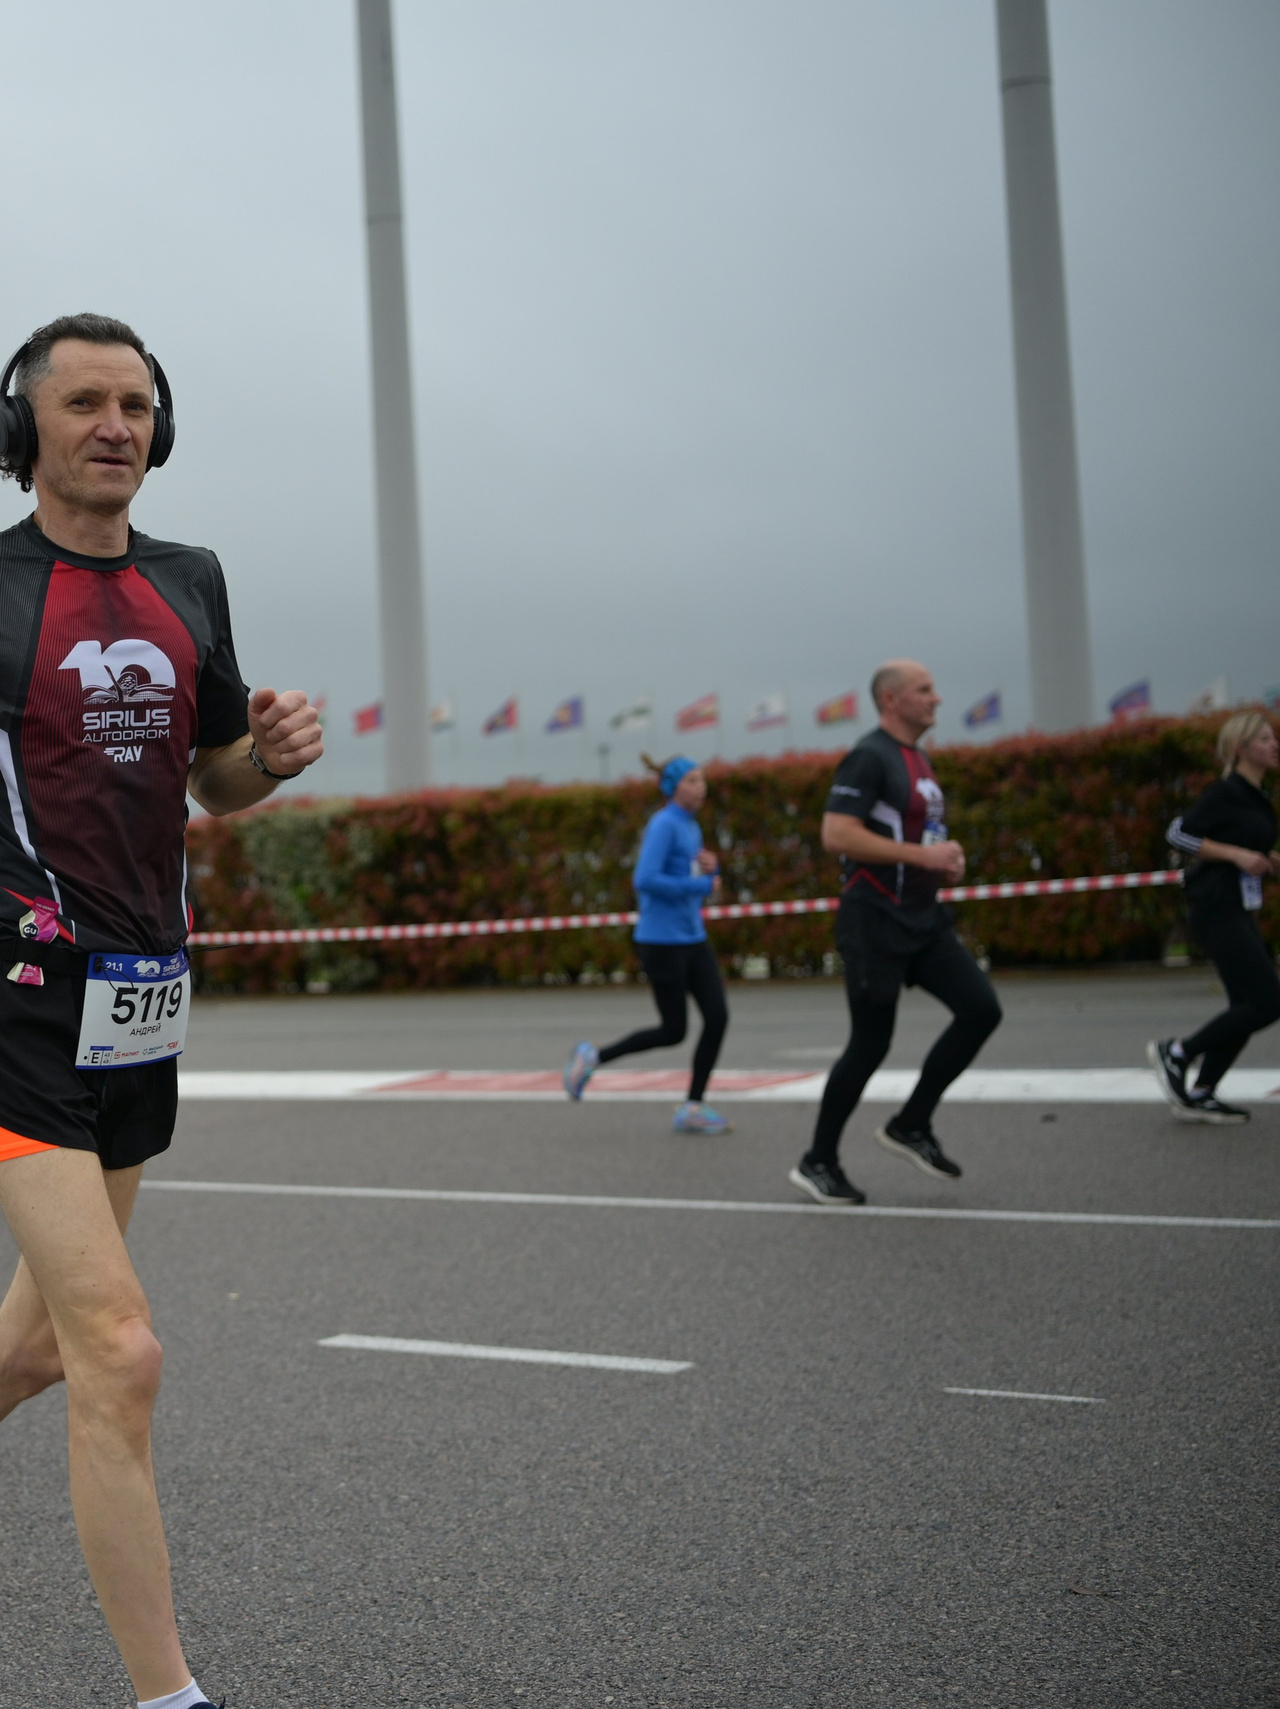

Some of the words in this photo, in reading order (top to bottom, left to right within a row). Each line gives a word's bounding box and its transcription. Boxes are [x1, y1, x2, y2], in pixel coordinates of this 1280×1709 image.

[57, 639, 176, 704] 10
[82, 708, 171, 730] SIRIUS
[82, 729, 170, 743] AUTODROM
[103, 745, 143, 763] RAY
[24, 926, 37, 935] GU
[106, 961, 123, 972] 21.1
[111, 981, 183, 1025] 5119
[130, 1022, 161, 1036] АНДРЕЙ
